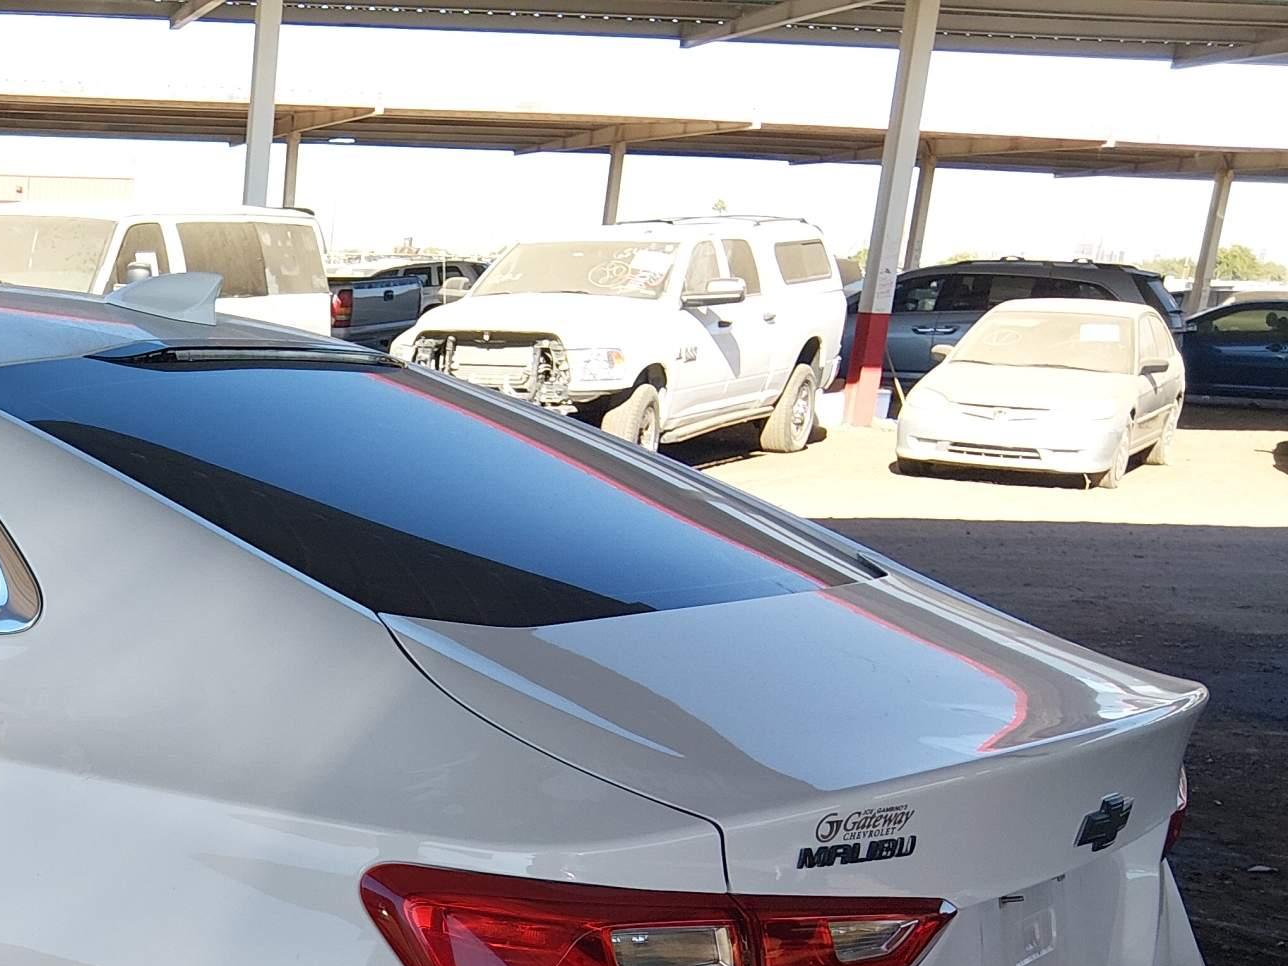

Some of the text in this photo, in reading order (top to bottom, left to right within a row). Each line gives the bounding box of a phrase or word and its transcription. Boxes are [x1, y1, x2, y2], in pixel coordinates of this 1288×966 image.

[843, 809, 915, 832] Gateway
[843, 826, 897, 841] CHEVROLET
[796, 834, 917, 870] MALIBU
